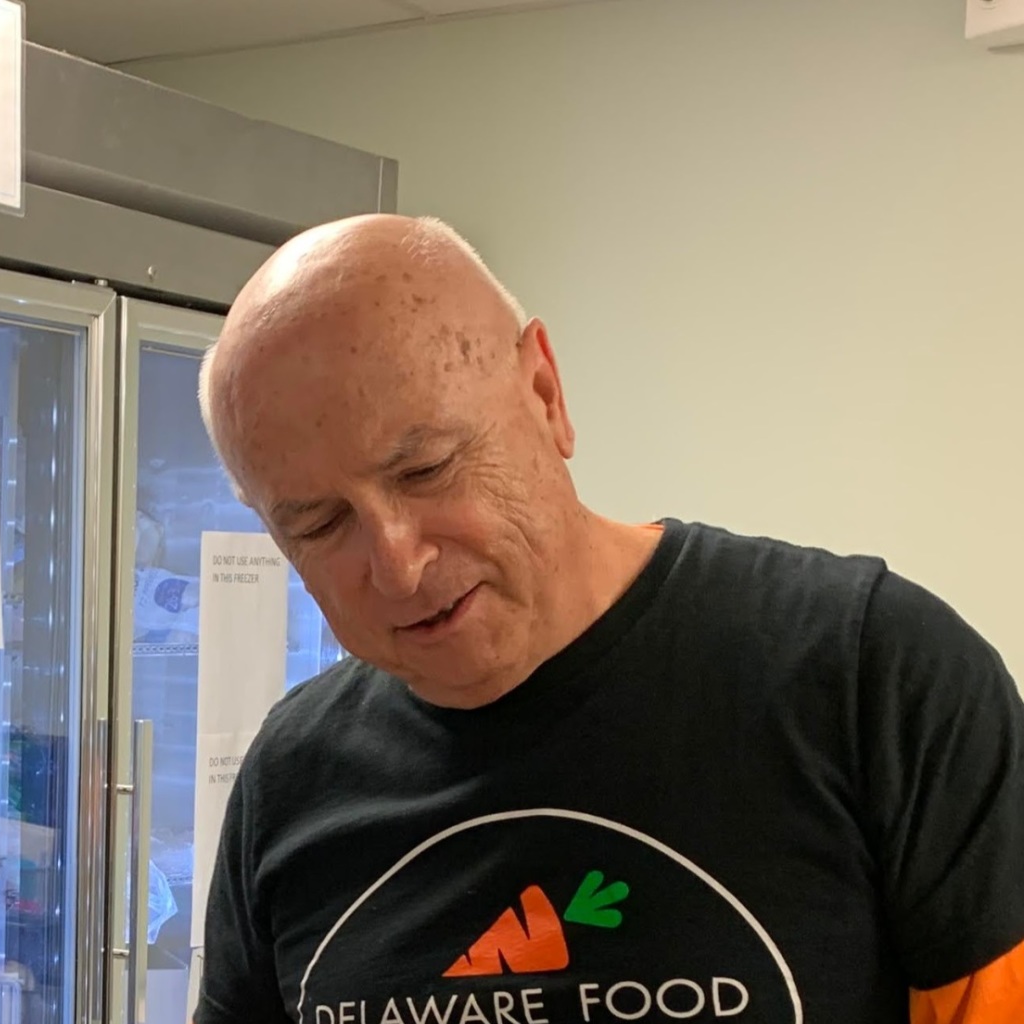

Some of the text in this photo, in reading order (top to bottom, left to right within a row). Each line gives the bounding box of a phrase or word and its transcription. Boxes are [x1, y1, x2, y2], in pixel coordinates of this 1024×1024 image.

[213, 554, 222, 566] DO
[223, 555, 235, 566] NOT
[237, 556, 248, 566] USE
[579, 976, 749, 1022] FOOD
